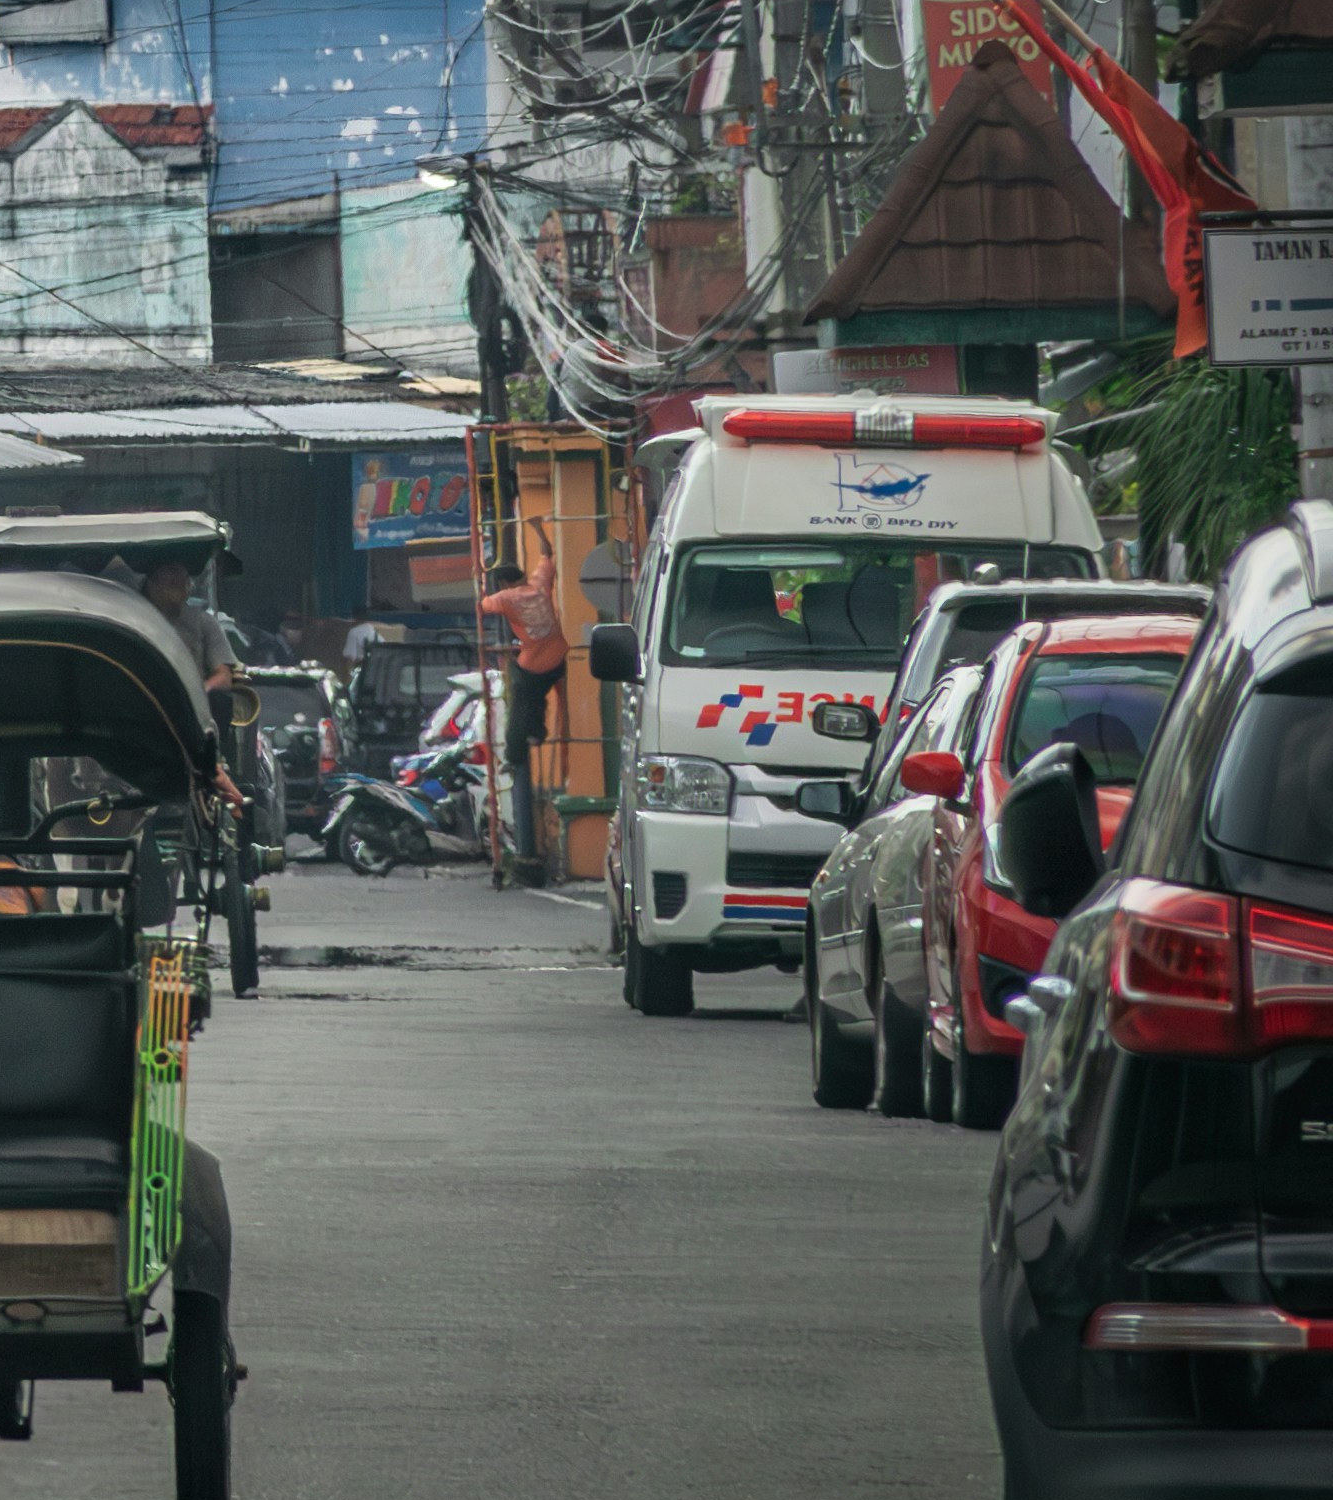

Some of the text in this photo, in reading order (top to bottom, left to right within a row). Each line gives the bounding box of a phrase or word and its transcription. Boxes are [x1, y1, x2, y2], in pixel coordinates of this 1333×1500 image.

[1252, 239, 1312, 261] TAMAN
[1240, 326, 1299, 339] ALAMAT
[809, 515, 958, 530] BANK BPD DIY
